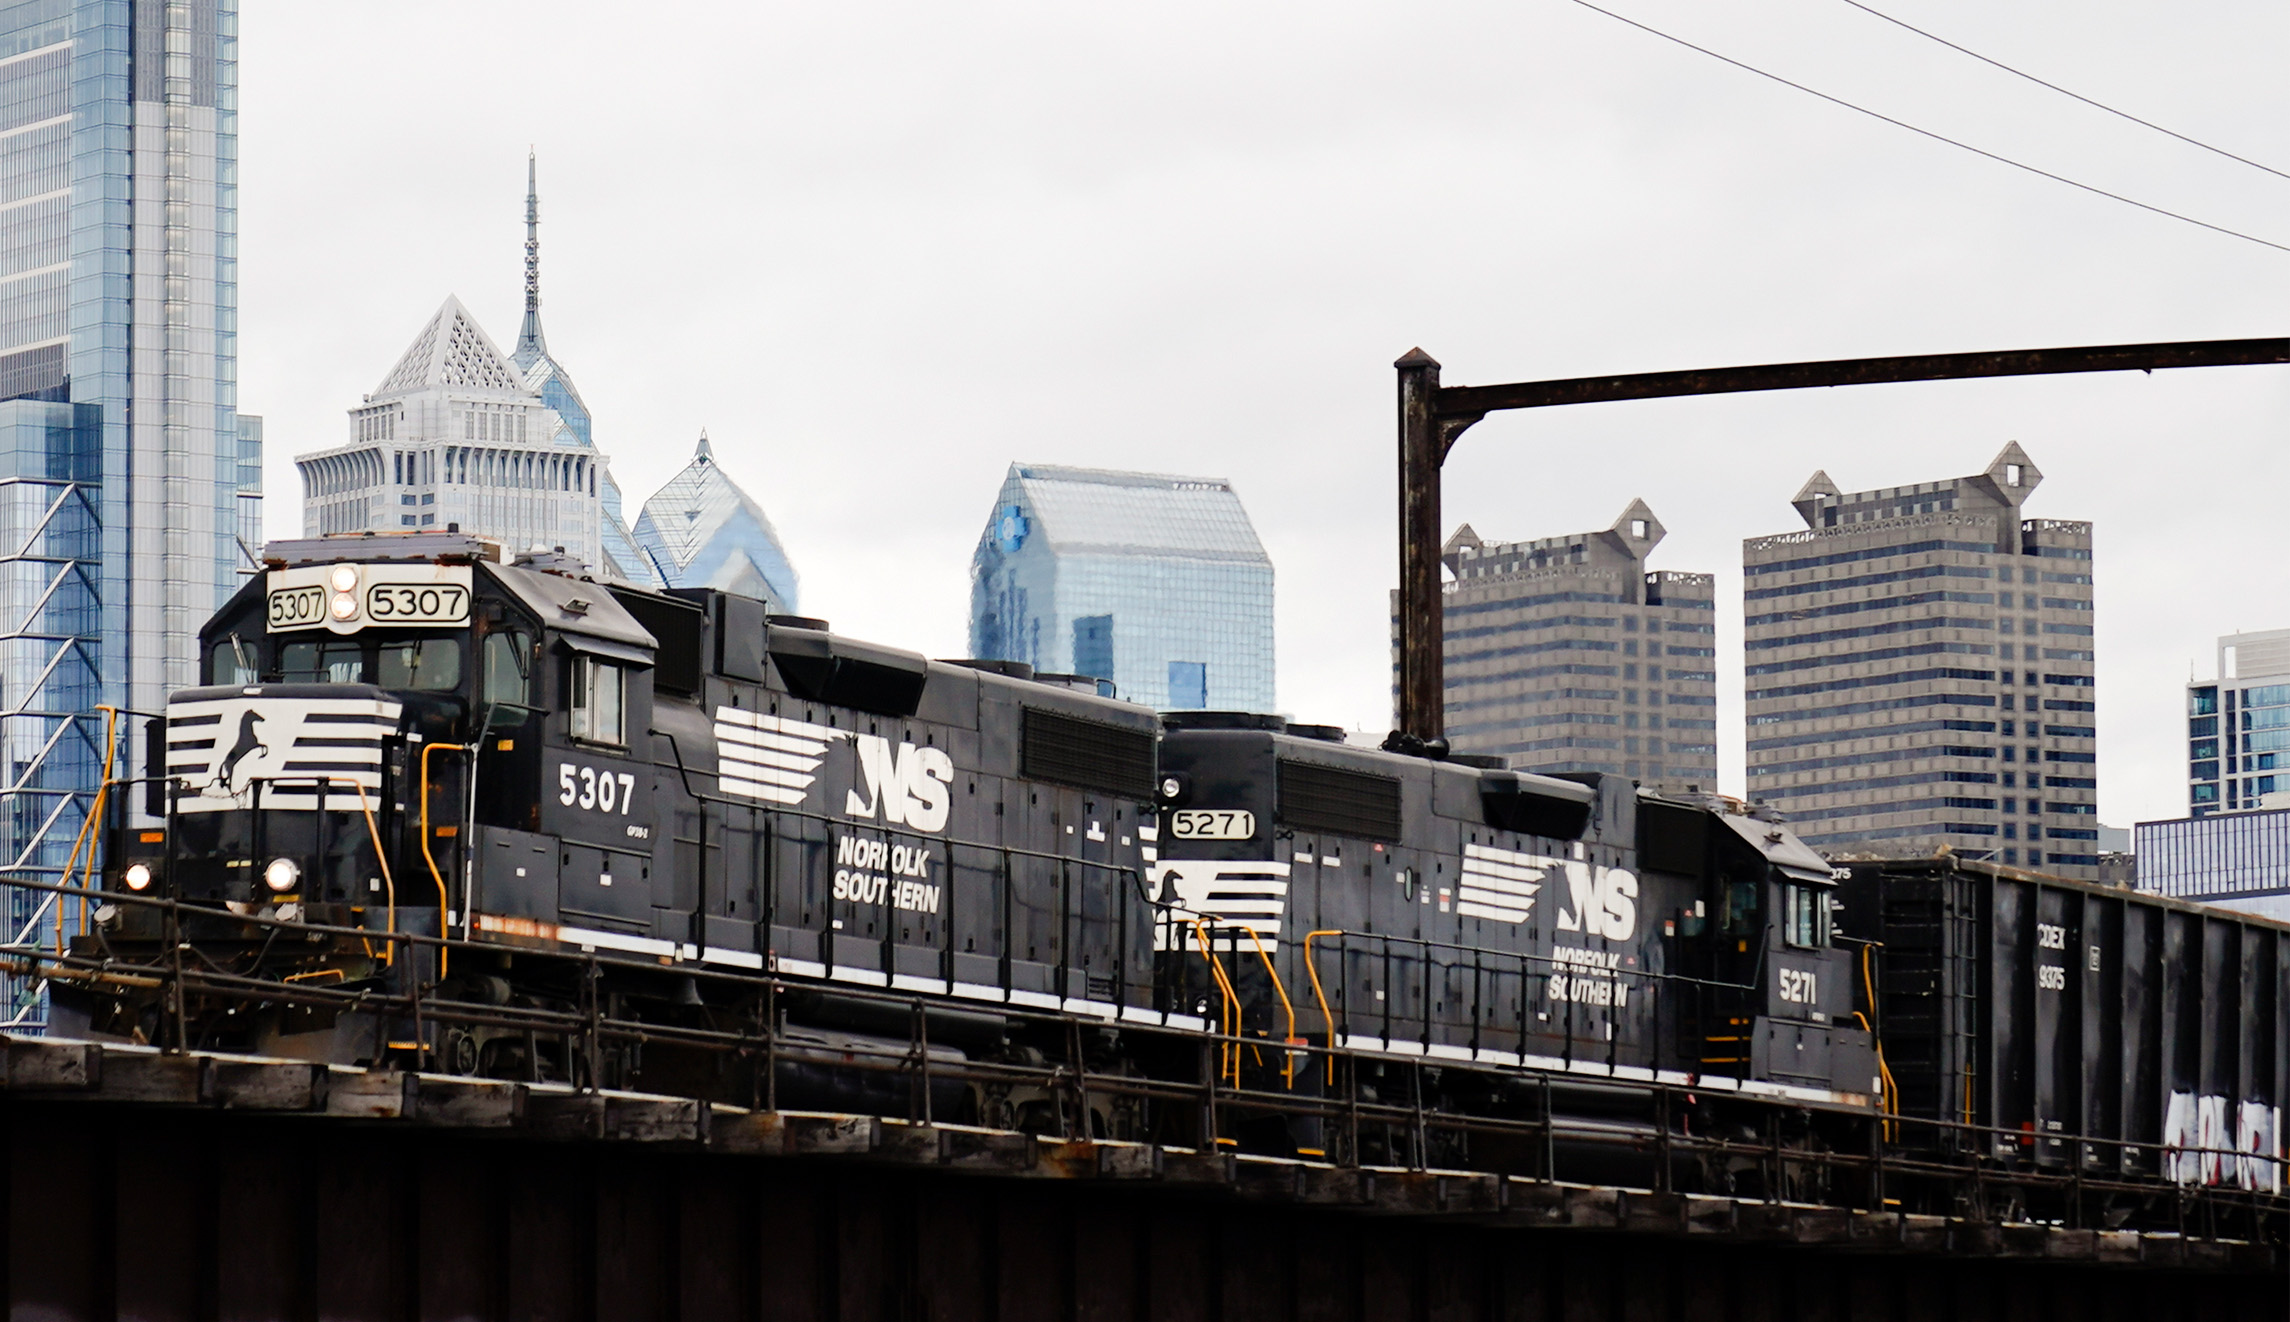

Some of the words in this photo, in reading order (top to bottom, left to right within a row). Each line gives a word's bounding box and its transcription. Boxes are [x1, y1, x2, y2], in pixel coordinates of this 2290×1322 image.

[272, 591, 323, 622] 5307
[373, 589, 463, 616] 5307
[560, 763, 635, 815] 5307
[845, 732, 954, 833] NS
[1176, 812, 1250, 836] 5271
[837, 835, 930, 878] NORFOLK
[833, 869, 940, 914] SOUTHERN
[1552, 945, 1620, 977] NORFOLK
[1779, 968, 1816, 1004] 5271
